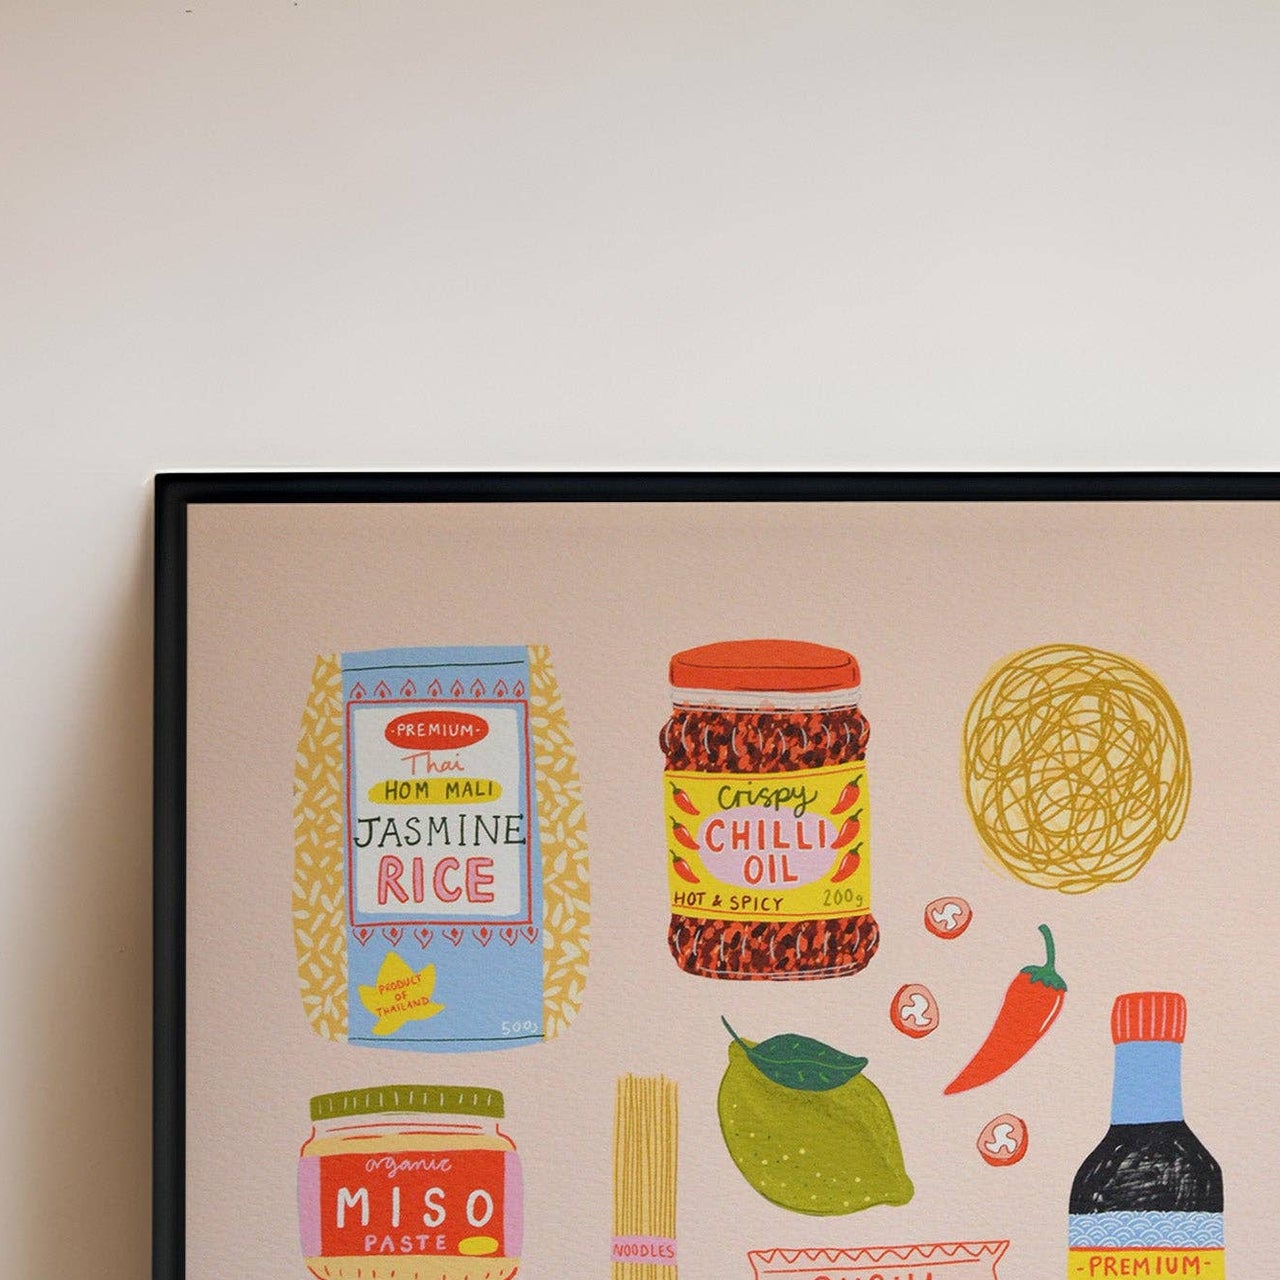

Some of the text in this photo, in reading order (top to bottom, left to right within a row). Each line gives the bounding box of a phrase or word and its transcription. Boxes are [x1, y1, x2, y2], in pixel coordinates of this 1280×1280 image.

[401, 751, 465, 776] Thai
[385, 781, 493, 799] HOM MALI
[718, 781, 818, 818] Crispy
[353, 814, 526, 849] JASMINE
[704, 818, 827, 853] CHILLI
[376, 855, 495, 905] RICE
[743, 854, 799, 885] OIL
[674, 892, 784, 912] HOT & SPICY
[823, 888, 864, 907] 200g
[378, 974, 421, 995] PRODUCT
[394, 990, 408, 1001] OF
[376, 996, 430, 1017] THAILAND
[335, 1187, 494, 1228] MISO
[364, 1234, 447, 1253] PASTE
[613, 1244, 675, 1258] NOODLES
